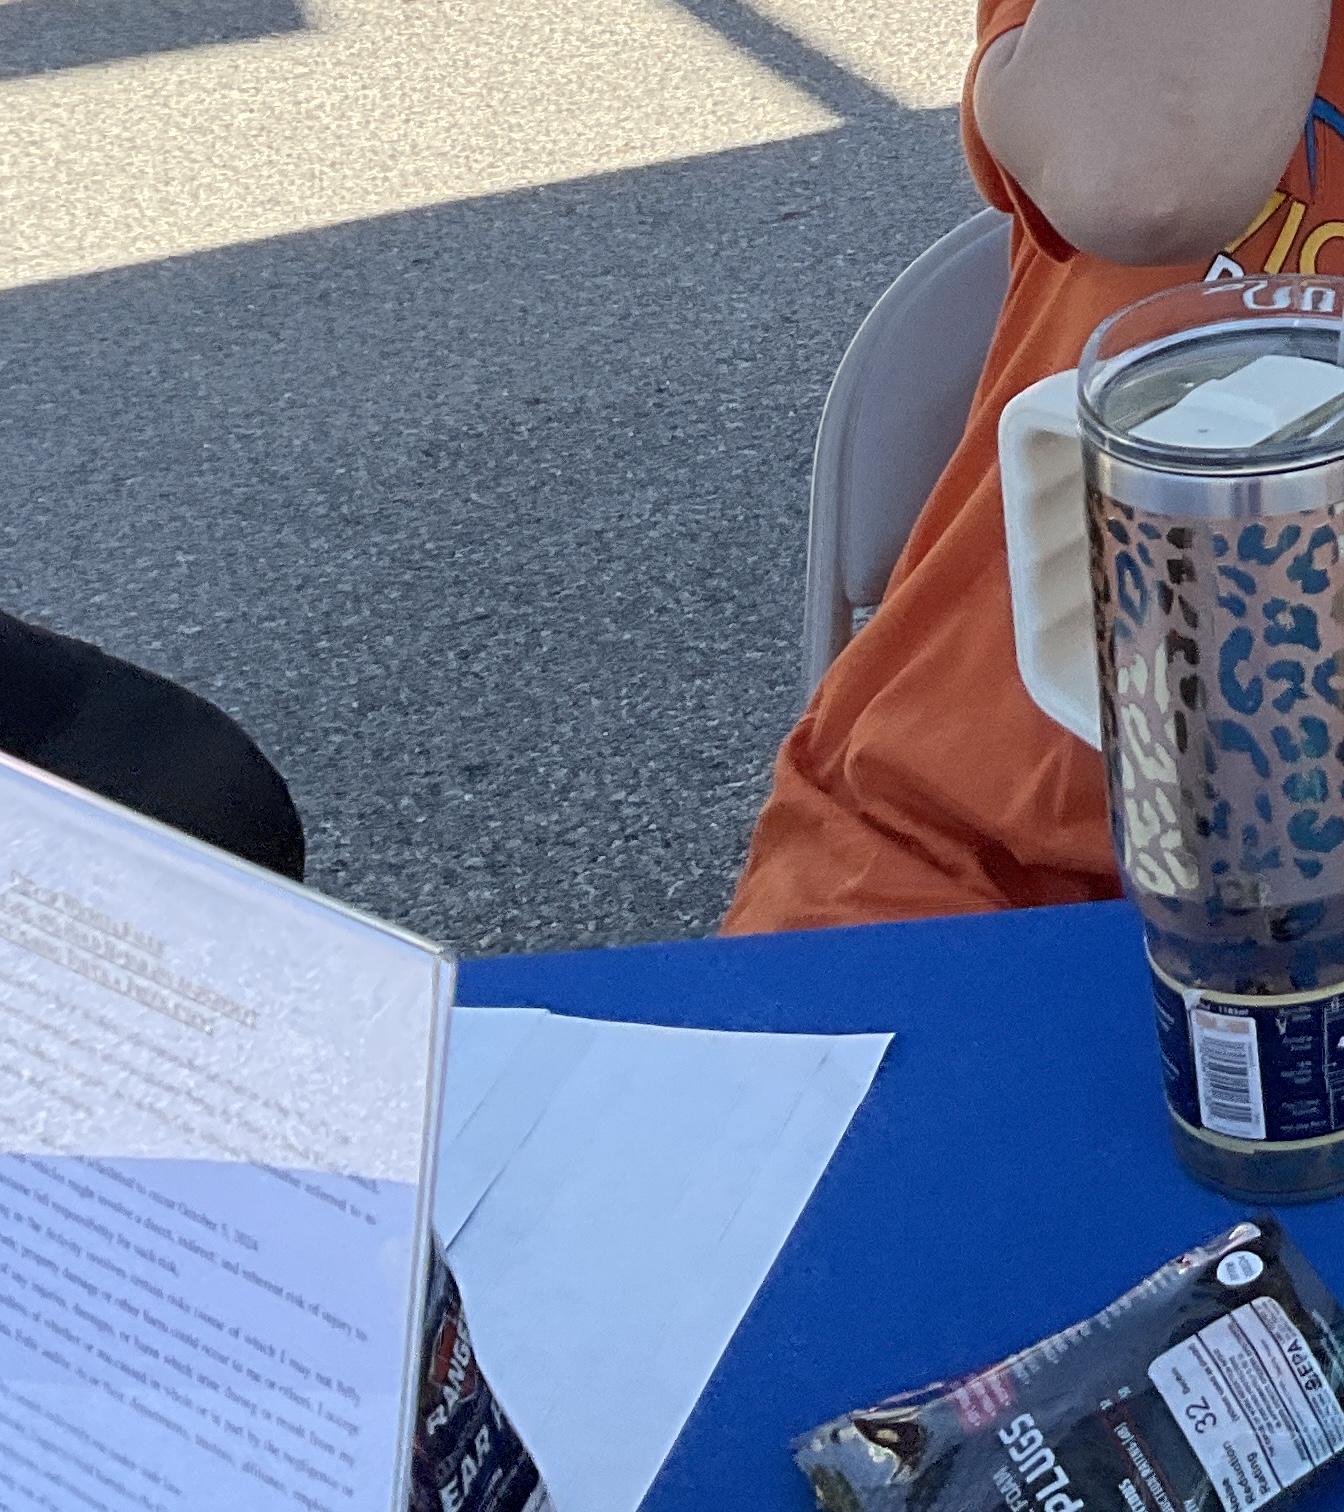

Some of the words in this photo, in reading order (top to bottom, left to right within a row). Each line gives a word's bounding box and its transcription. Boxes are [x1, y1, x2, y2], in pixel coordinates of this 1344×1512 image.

[1287, 1337, 1311, 1377] EPA
[1185, 1396, 1217, 1434] 32
[1222, 1440, 1257, 1505] Reduction
[1247, 1451, 1269, 1496] Rating
